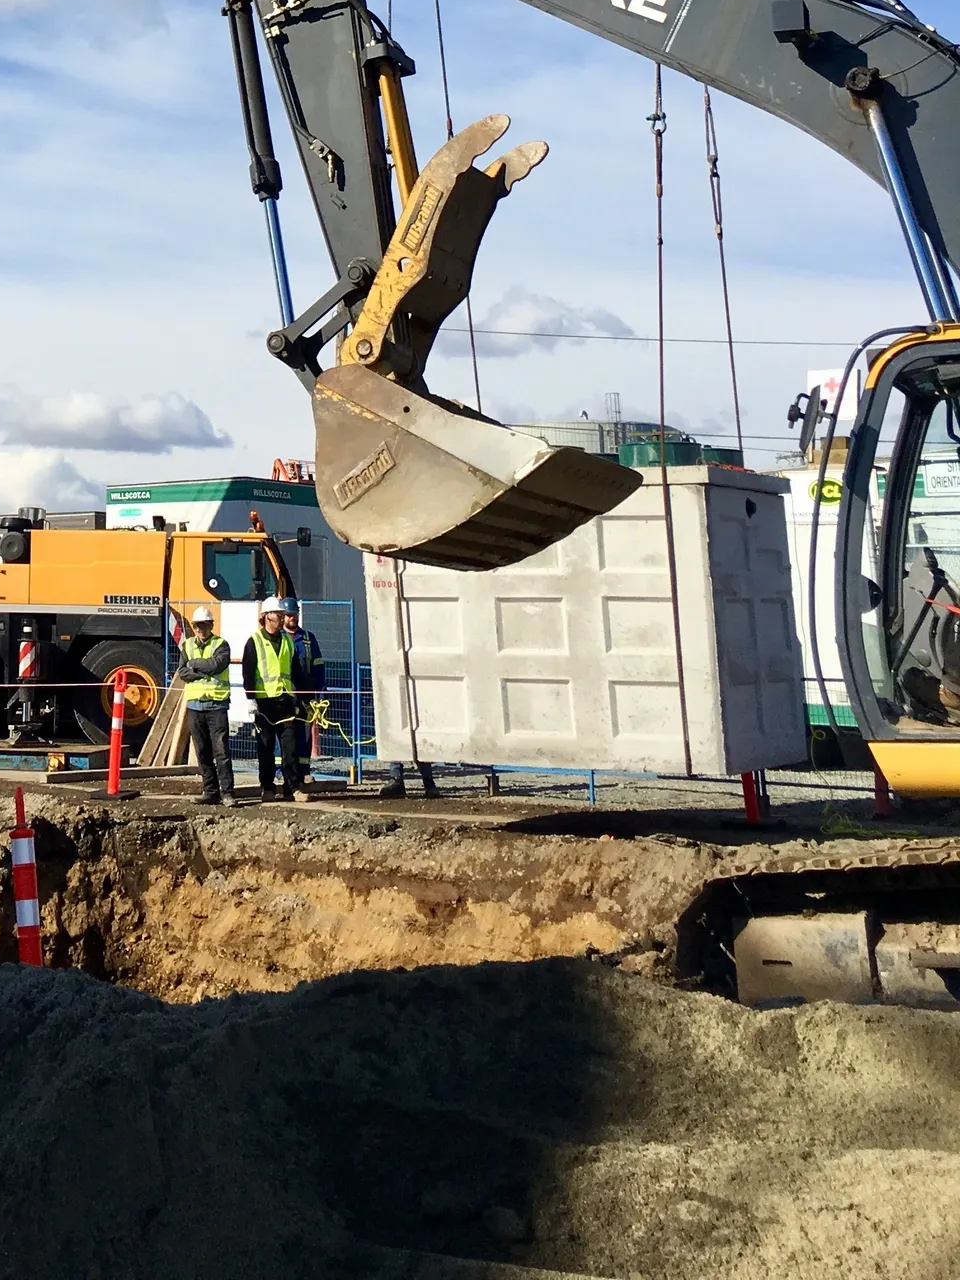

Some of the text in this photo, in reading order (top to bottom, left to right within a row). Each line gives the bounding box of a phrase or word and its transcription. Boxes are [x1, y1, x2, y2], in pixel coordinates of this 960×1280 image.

[947, 462, 960, 472] SIT
[111, 491, 150, 500] WILLSCOT.CA
[104, 595, 160, 605] LIEBHERR
